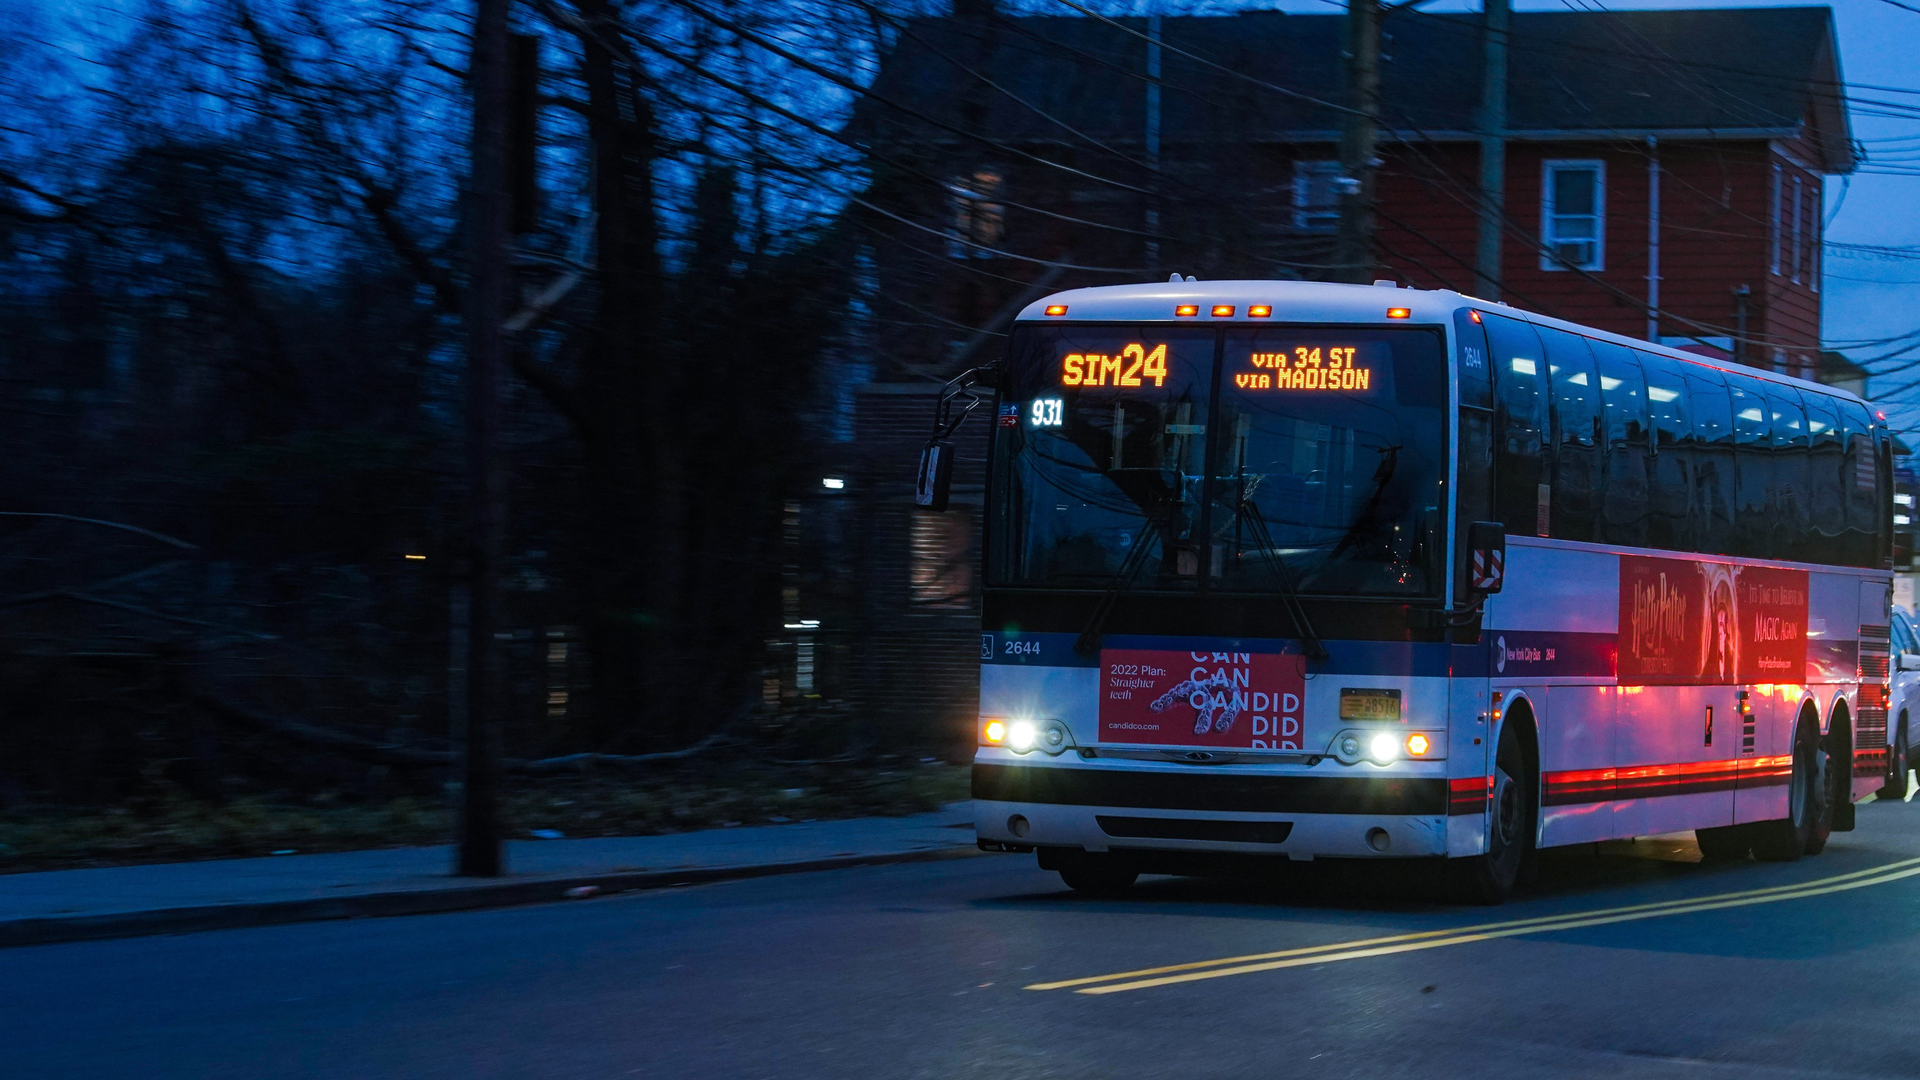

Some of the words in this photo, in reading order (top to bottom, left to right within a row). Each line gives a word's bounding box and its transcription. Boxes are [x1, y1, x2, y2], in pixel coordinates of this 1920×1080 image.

[1063, 344, 1167, 386] SIM24
[1252, 354, 1287, 368] VIA
[1294, 347, 1321, 368] 34
[1329, 347, 1356, 369] ST
[1464, 346, 1482, 368] 2644
[1236, 374, 1270, 388] VIA
[1278, 368, 1369, 389] MADISON
[1031, 399, 1063, 426] 931
[1005, 641, 1041, 655] 2644
[1507, 648, 1516, 660] New
[1525, 647, 1533, 663] City
[1533, 648, 1541, 660] Bus
[1110, 664, 1138, 675] 2022
[1141, 665, 1166, 676] Plan:
[1190, 666, 1249, 688] CAN
[1110, 677, 1155, 690] Straighter
[1109, 690, 1132, 700] teeth
[1189, 690, 1300, 713] CANDID
[1108, 722, 1160, 731] candidco.com
[1252, 715, 1299, 736] DID
